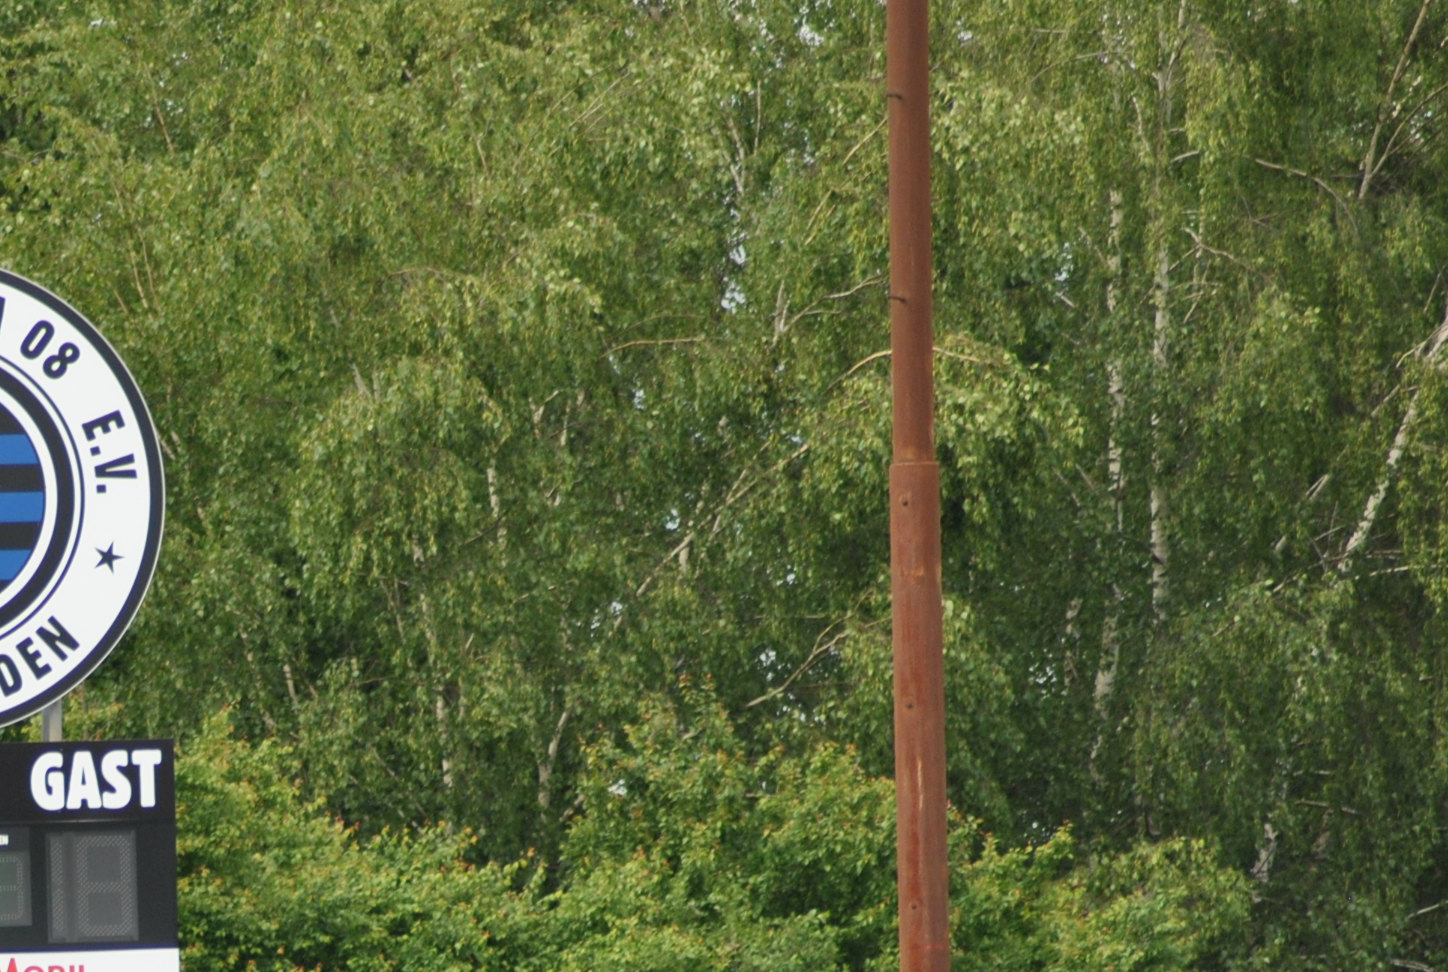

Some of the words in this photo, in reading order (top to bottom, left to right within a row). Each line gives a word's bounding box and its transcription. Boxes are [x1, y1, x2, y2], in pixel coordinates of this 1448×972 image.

[19, 319, 80, 380] 08
[81, 409, 138, 494] E.V.
[30, 749, 162, 811] GAST
